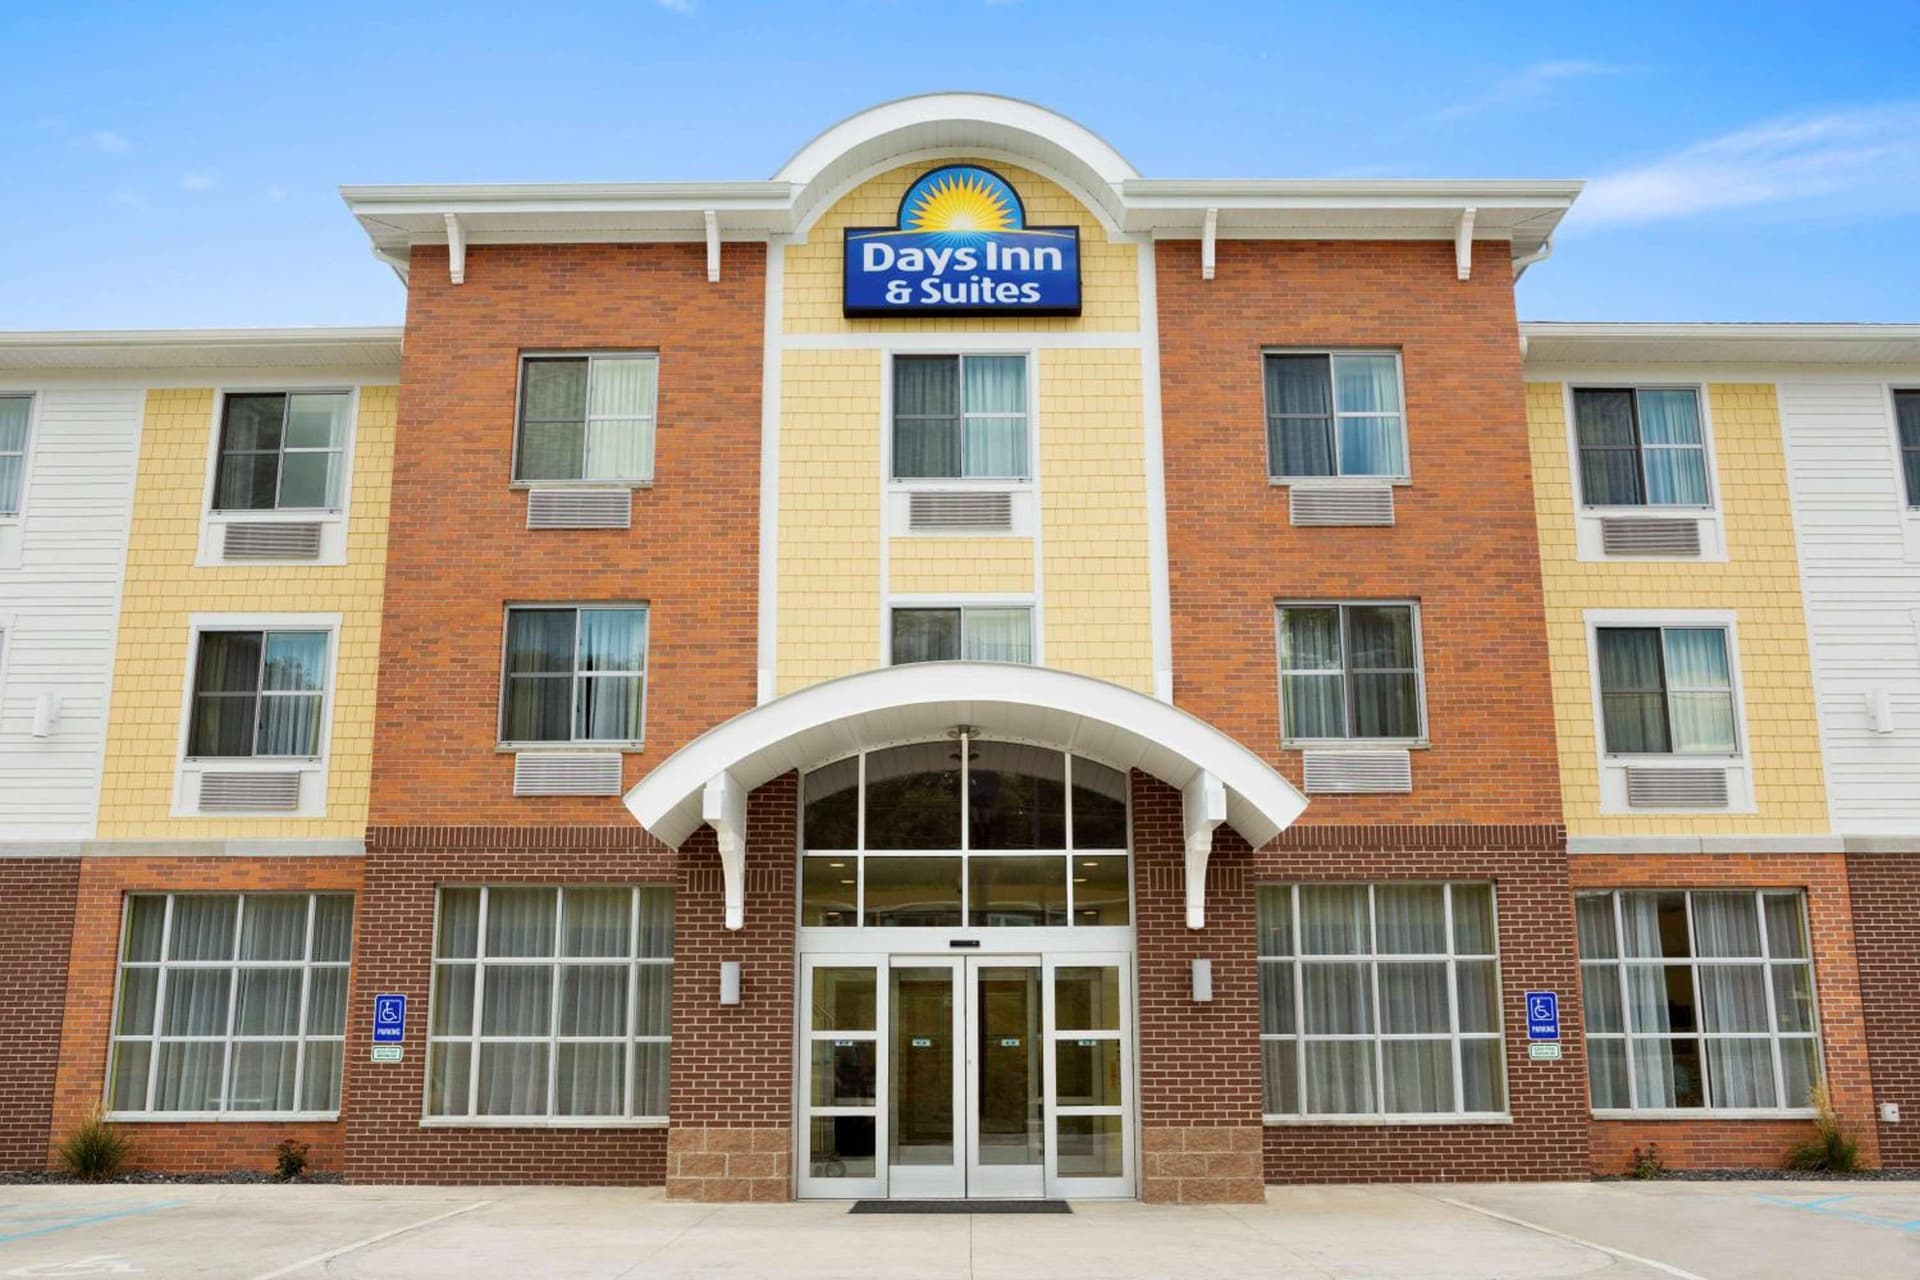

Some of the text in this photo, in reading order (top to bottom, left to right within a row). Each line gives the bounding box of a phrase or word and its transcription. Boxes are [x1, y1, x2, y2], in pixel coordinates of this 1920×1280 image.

[863, 241, 1063, 276] Days Inn
[885, 275, 1041, 304] & Suites
[1532, 1025, 1555, 1033] PARKING
